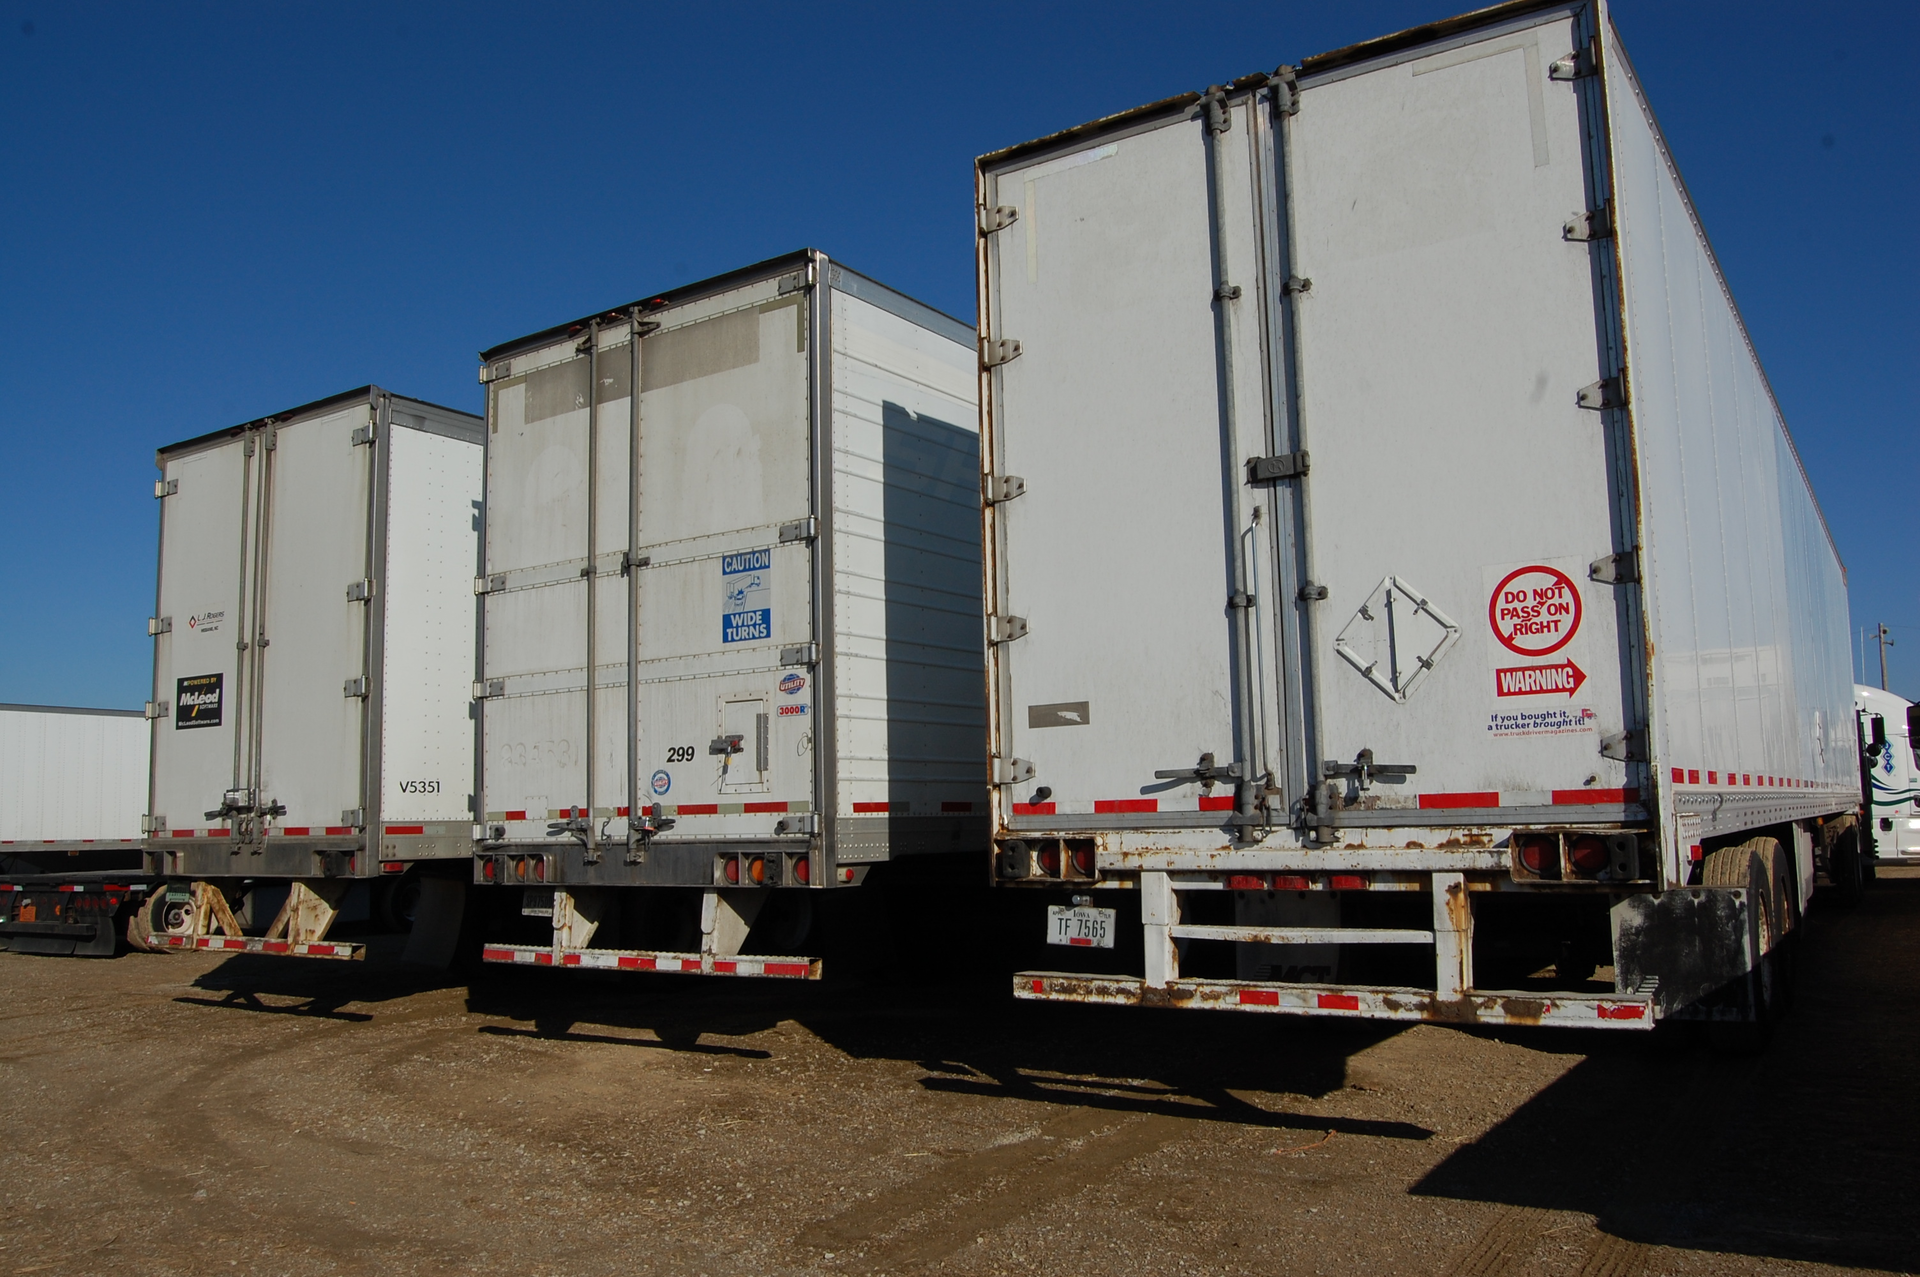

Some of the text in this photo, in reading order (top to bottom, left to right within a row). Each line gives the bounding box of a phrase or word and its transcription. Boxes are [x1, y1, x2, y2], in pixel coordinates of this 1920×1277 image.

[724, 551, 769, 573] CAUTION
[1504, 586, 1565, 604] DO NOT
[730, 611, 763, 627] WIDE
[1500, 602, 1570, 621] PASS ON
[726, 624, 767, 641] TURNS
[1513, 619, 1562, 636] RIGHT
[780, 679, 805, 690] UTILITY
[1500, 666, 1574, 693] WARNING
[180, 688, 219, 706] McLeod
[779, 705, 807, 716] 3000R
[1491, 709, 1570, 724] If you bought it,
[1493, 727, 1593, 737] www.truckdrivermagazines.com
[1495, 721, 1531, 731] trucker
[1533, 718, 1573, 729] brought
[1574, 716, 1585, 726] it!
[666, 745, 695, 763] 299
[399, 780, 440, 794] V5351
[1057, 917, 1106, 939] TF 7565
